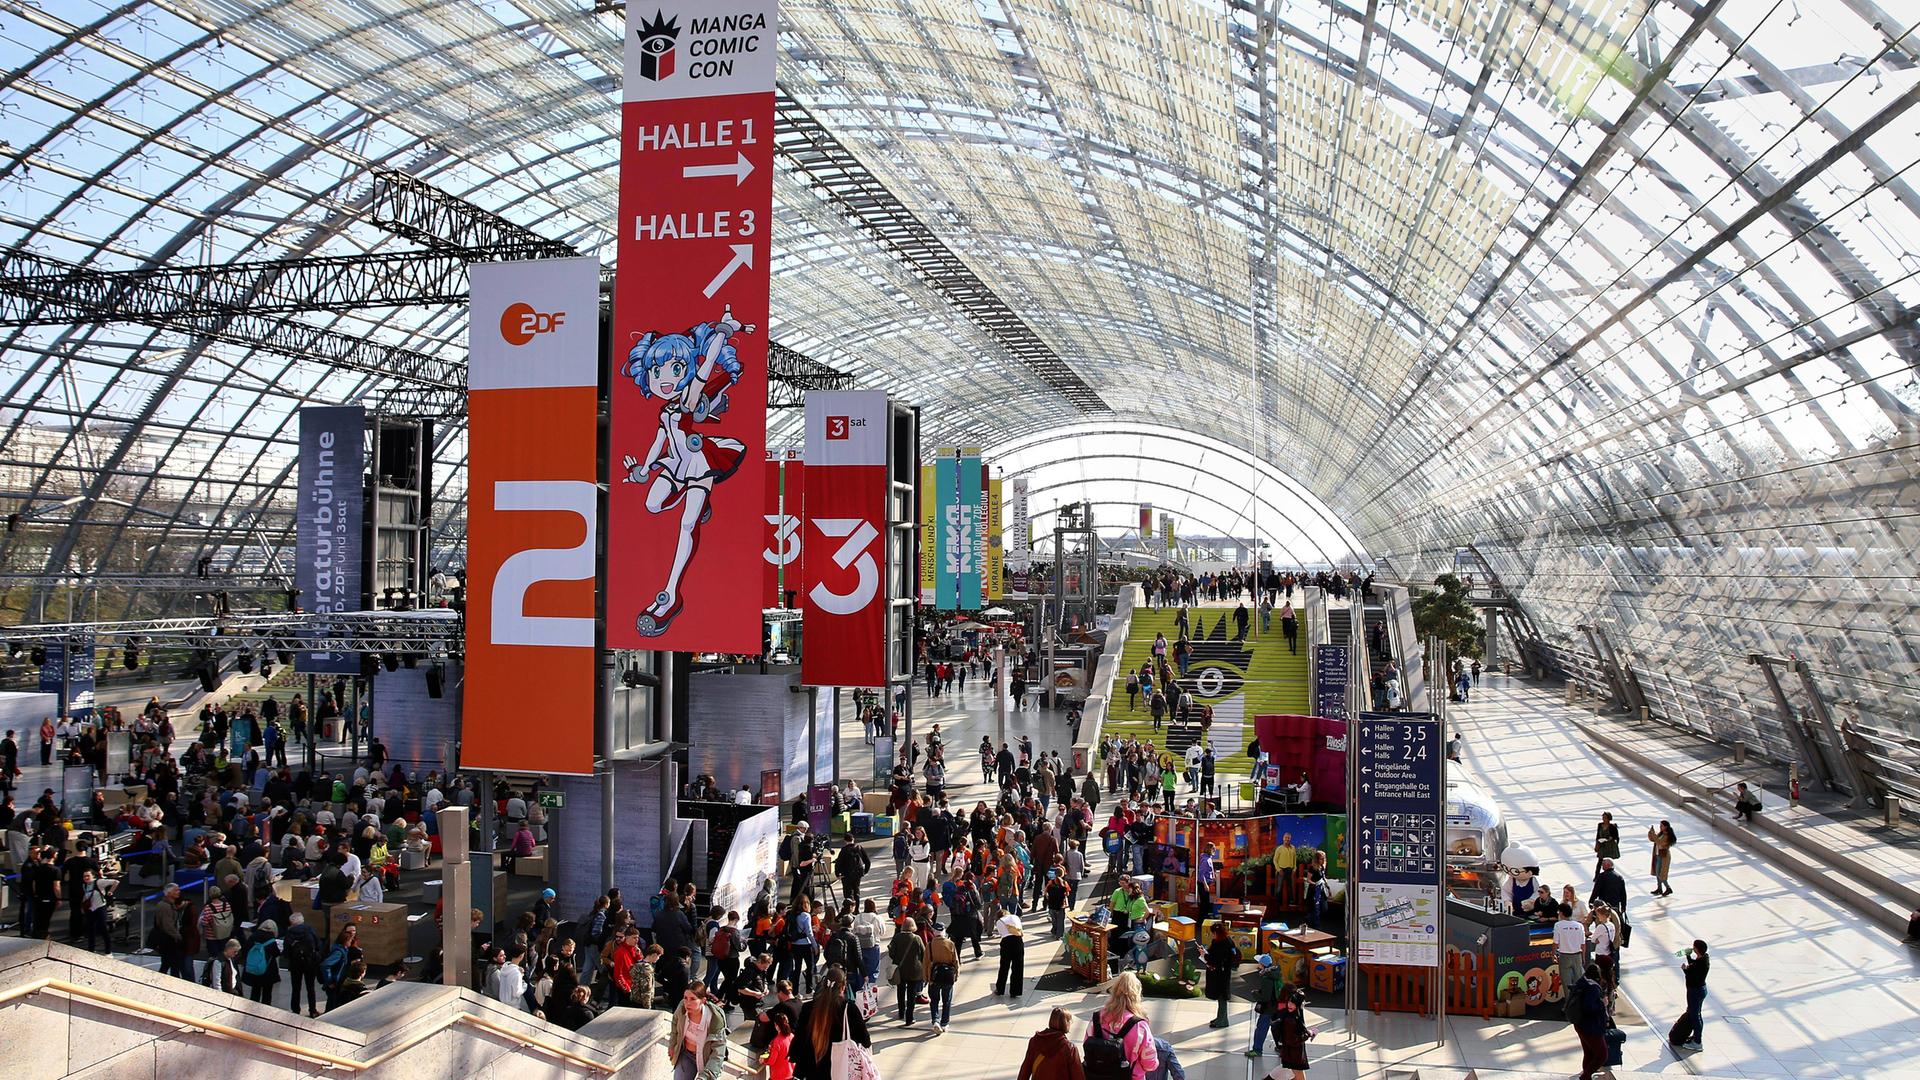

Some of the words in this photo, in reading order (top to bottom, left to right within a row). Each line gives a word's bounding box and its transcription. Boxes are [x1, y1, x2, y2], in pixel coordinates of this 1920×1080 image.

[690, 13, 767, 35] MANGA
[690, 35, 759, 57] COMIC
[689, 59, 734, 79] CON
[638, 120, 733, 150] HALLE
[741, 118, 757, 145] 1
[635, 211, 730, 240] HALLE
[738, 209, 756, 236] 3
[337, 500, 347, 533] 3sat
[336, 537, 346, 562] und
[490, 480, 597, 647] 2
[808, 518, 879, 615] 3
[335, 566, 345, 595] ZDF
[1374, 724, 1395, 732] Hallen
[1403, 725, 1426, 743] 3,5
[1374, 732, 1390, 740] Halls
[1374, 743, 1395, 751] Hallen
[1403, 744, 1427, 761] 2,4
[1374, 751, 1390, 759] Halls
[1374, 762, 1411, 771] Freigelände
[1401, 771, 1417, 779] Area
[1374, 781, 1417, 791] Eingangshalle
[1418, 783, 1430, 791] Ost
[1374, 790, 1402, 798] Entrance
[1416, 791, 1431, 799] East
